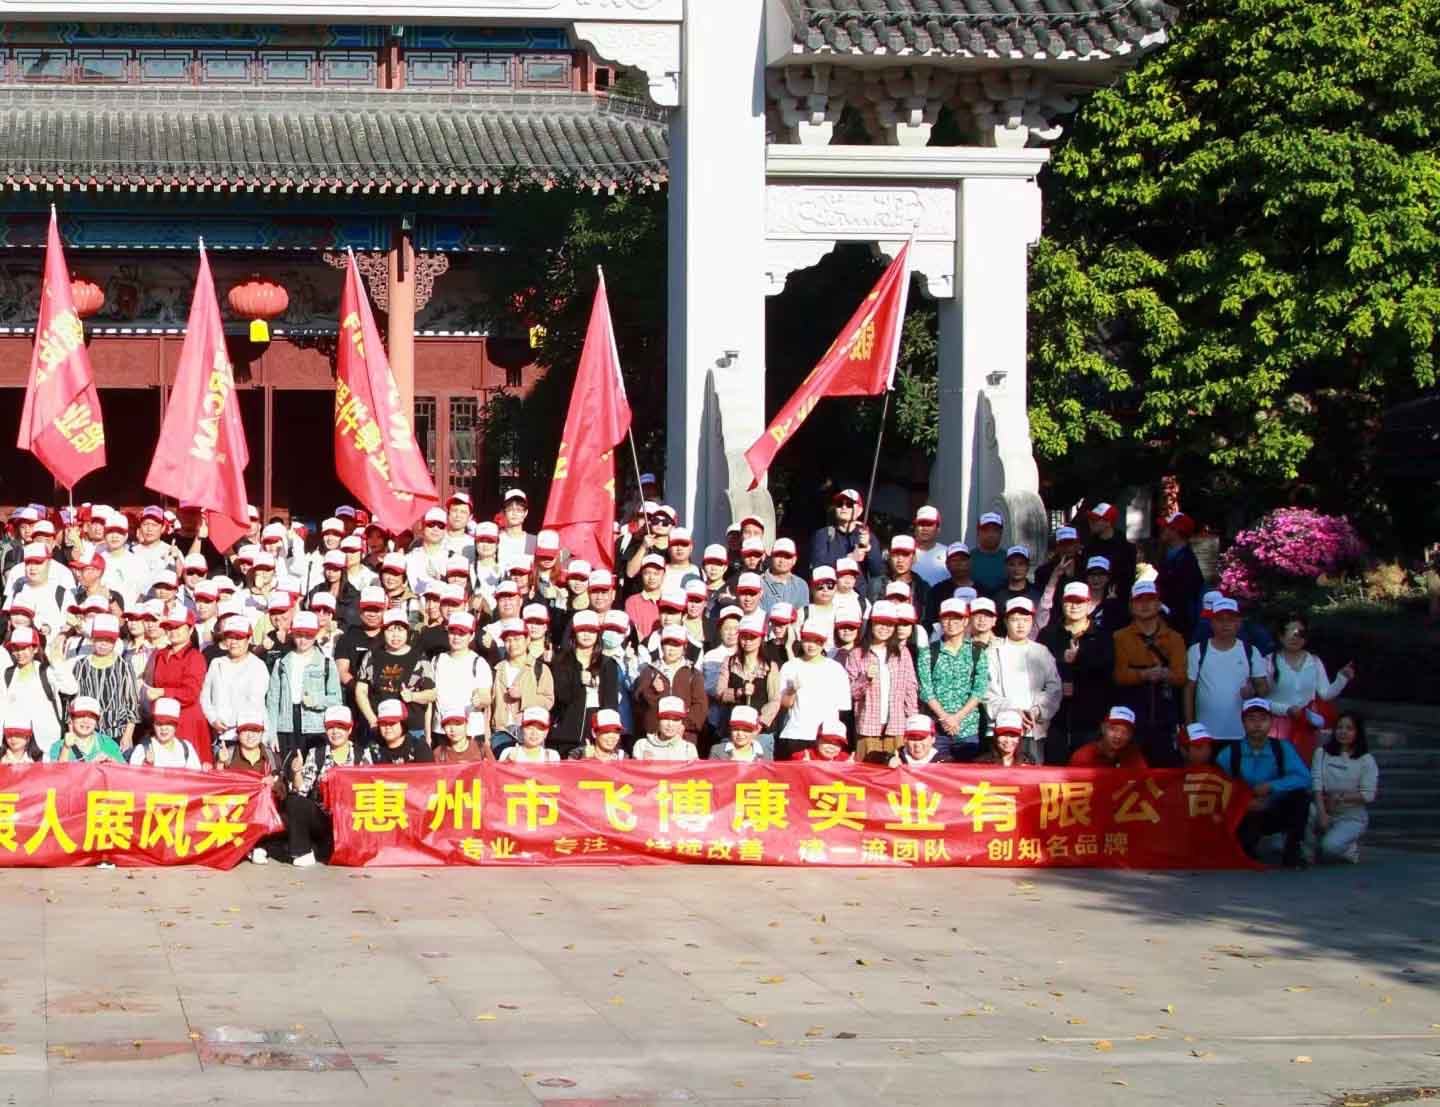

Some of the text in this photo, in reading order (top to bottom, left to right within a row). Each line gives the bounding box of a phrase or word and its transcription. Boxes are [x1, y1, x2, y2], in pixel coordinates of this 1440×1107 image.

[351, 773, 1233, 832] 惠州市飞博康实业有限公司
